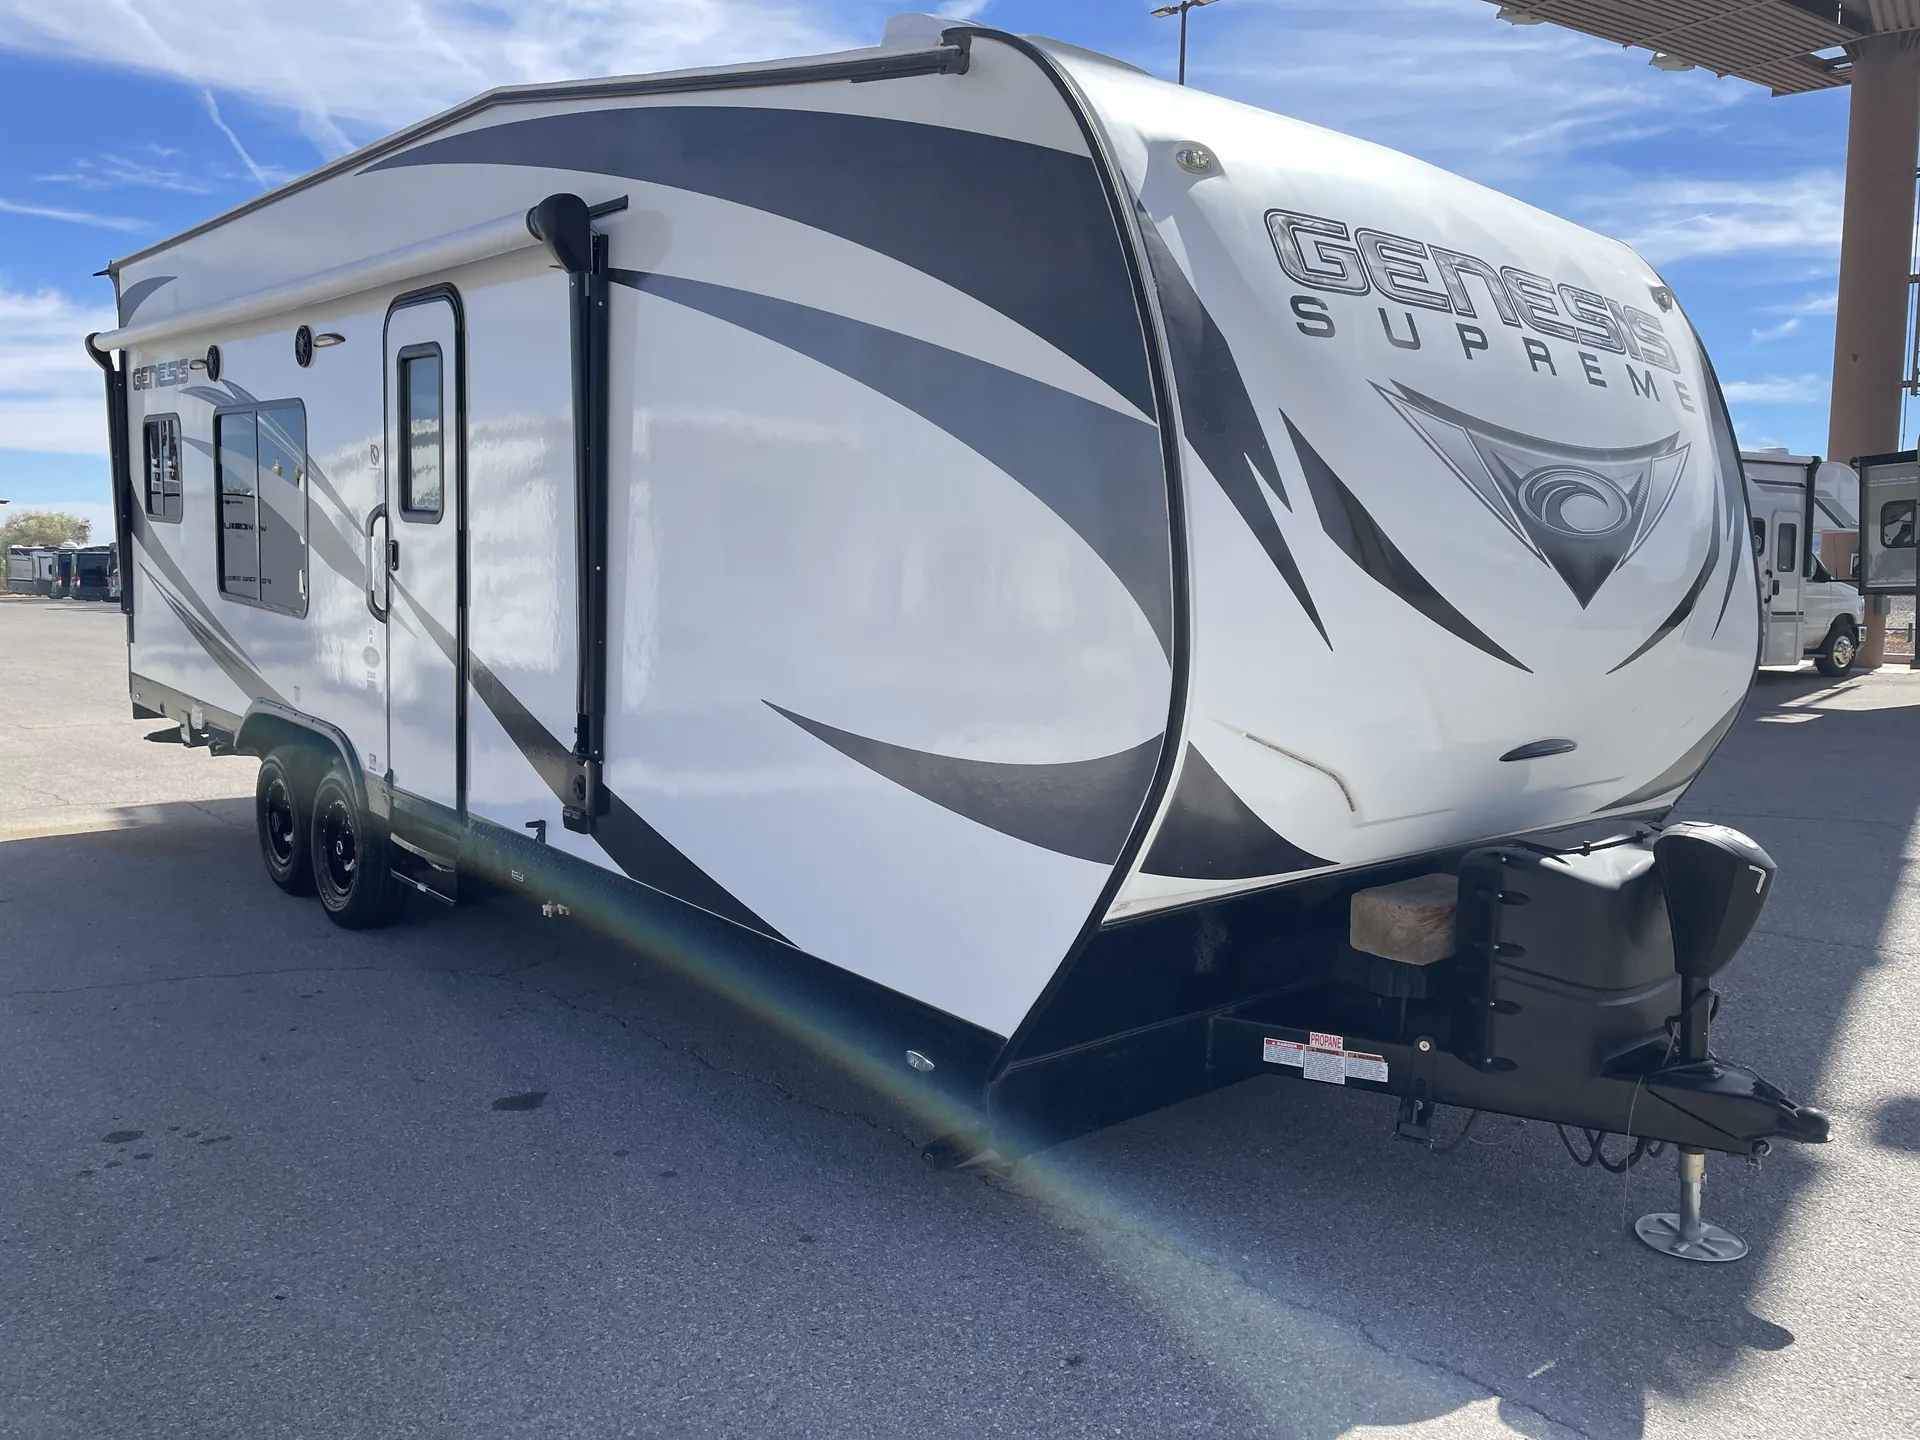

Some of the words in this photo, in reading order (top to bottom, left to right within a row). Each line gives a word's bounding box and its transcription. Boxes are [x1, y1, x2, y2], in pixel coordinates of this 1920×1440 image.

[1263, 208, 1680, 375] GENESIS
[133, 358, 188, 391] GENESIS
[1290, 295, 1695, 413] SUPREME
[1310, 1033, 1342, 1049] PROPANE
